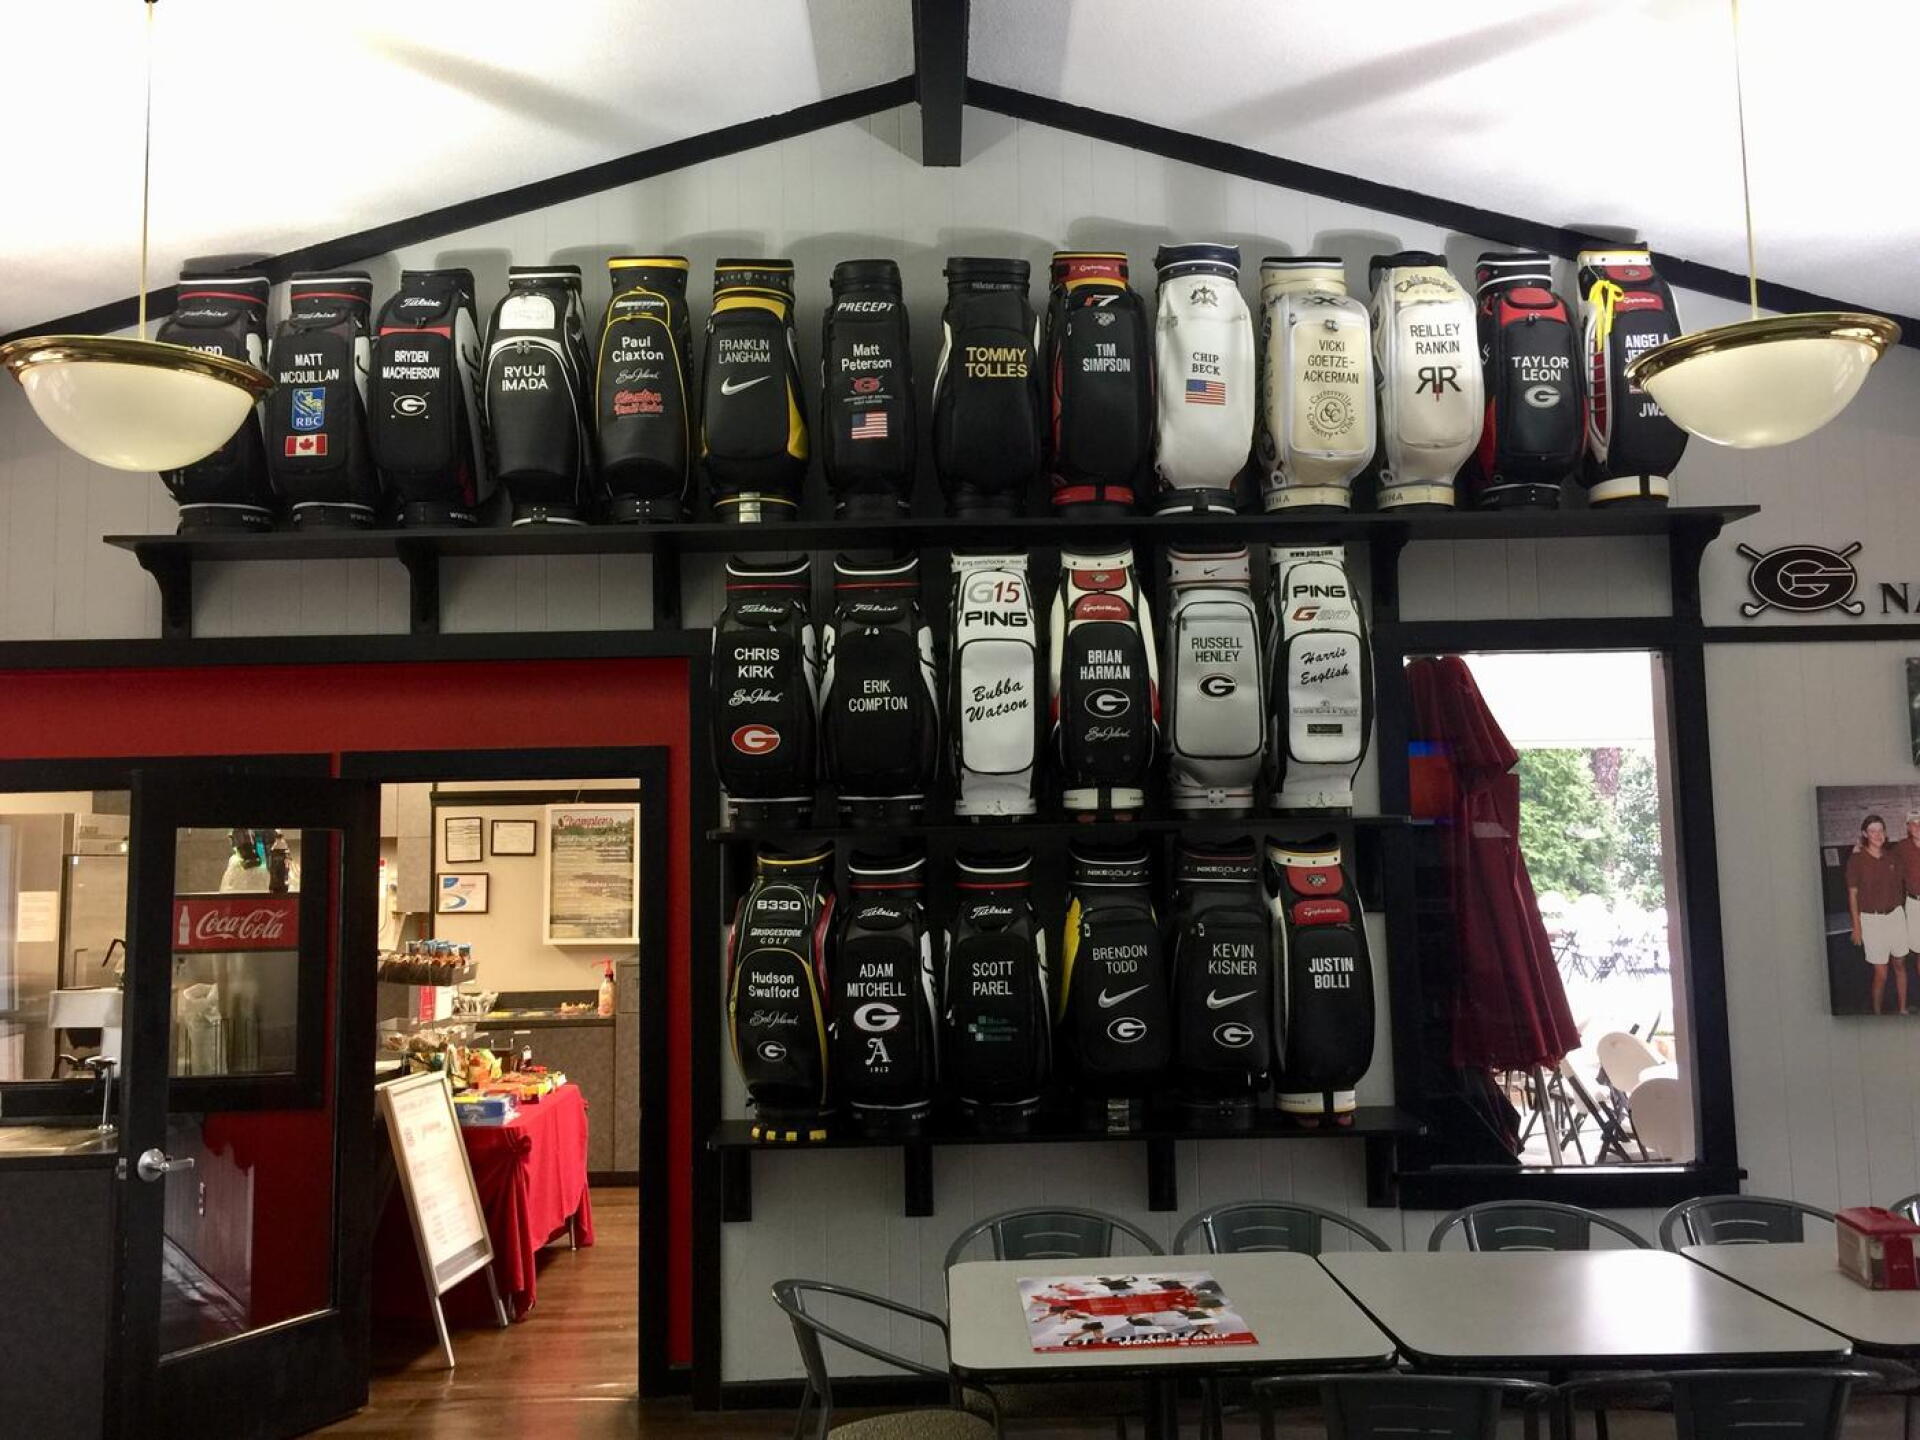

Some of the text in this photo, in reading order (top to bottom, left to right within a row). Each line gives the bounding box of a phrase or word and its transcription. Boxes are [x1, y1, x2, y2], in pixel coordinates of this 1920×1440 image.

[837, 302, 894, 313] PRECEPT
[1409, 323, 1461, 338] REILLEY
[621, 336, 651, 349] Paul
[719, 339, 770, 351] FRANKLIN
[852, 343, 880, 356] Matt
[1318, 340, 1345, 352] VICKI
[1414, 340, 1461, 355] RANKIN
[394, 350, 430, 363] BRYDEN
[612, 349, 665, 363] Claxton
[965, 347, 1027, 362] TOMMY
[1095, 343, 1117, 357] TIM
[294, 353, 324, 367] MATT
[718, 351, 771, 364] LANGHAM
[841, 357, 892, 372] Peterson
[1192, 352, 1219, 363] CHIP
[1307, 354, 1356, 369] GOETZE-
[1512, 356, 1570, 369] TAYLOR
[503, 364, 547, 378] RYUJI
[965, 363, 1028, 378] TOLLES
[1082, 358, 1131, 373] SIMPSON
[1192, 363, 1221, 376] BECK
[280, 368, 340, 384] MCQUILLAN
[382, 366, 441, 380] MACPHERSON
[1303, 370, 1360, 385] ACKERMAN
[1522, 368, 1562, 382] LEON
[501, 377, 549, 392] IMADA
[296, 417, 321, 427] RBC
[968, 581, 1021, 603] G15
[1293, 585, 1346, 598] PING
[965, 611, 1028, 627] PING
[1191, 637, 1243, 649] RUSSELL
[734, 648, 780, 661] CHRIS
[1088, 650, 1122, 664] BRIAN
[1195, 651, 1240, 663] HENLEY
[1301, 647, 1347, 665] Harris
[738, 665, 775, 679] KIRK
[1080, 665, 1131, 680] HARMAN
[1301, 664, 1349, 685] English
[863, 680, 890, 694] ERIK
[971, 680, 1024, 702] Bubba
[849, 696, 908, 712] COMPTON
[965, 699, 1029, 723] Watson
[757, 900, 801, 911] B330
[970, 905, 1013, 919] Titleist
[857, 907, 900, 919] Titleist
[196, 909, 288, 940] Coca-Cola
[751, 928, 802, 937] BRIDGESTONE
[760, 937, 790, 945] GOLF
[1092, 945, 1147, 960] BRENDON
[1213, 943, 1254, 959] KEVIN
[859, 963, 894, 978] ADAM
[972, 961, 1014, 977] SCOTT
[1106, 960, 1138, 974] TODD
[1208, 960, 1257, 976] KISNER
[1309, 957, 1354, 973] JUSTIN
[752, 971, 794, 984] Hudson
[1314, 974, 1350, 989] BOLLI
[748, 984, 799, 998] Swafford
[847, 981, 907, 998] MITCHELL
[972, 981, 1013, 996] PAREL
